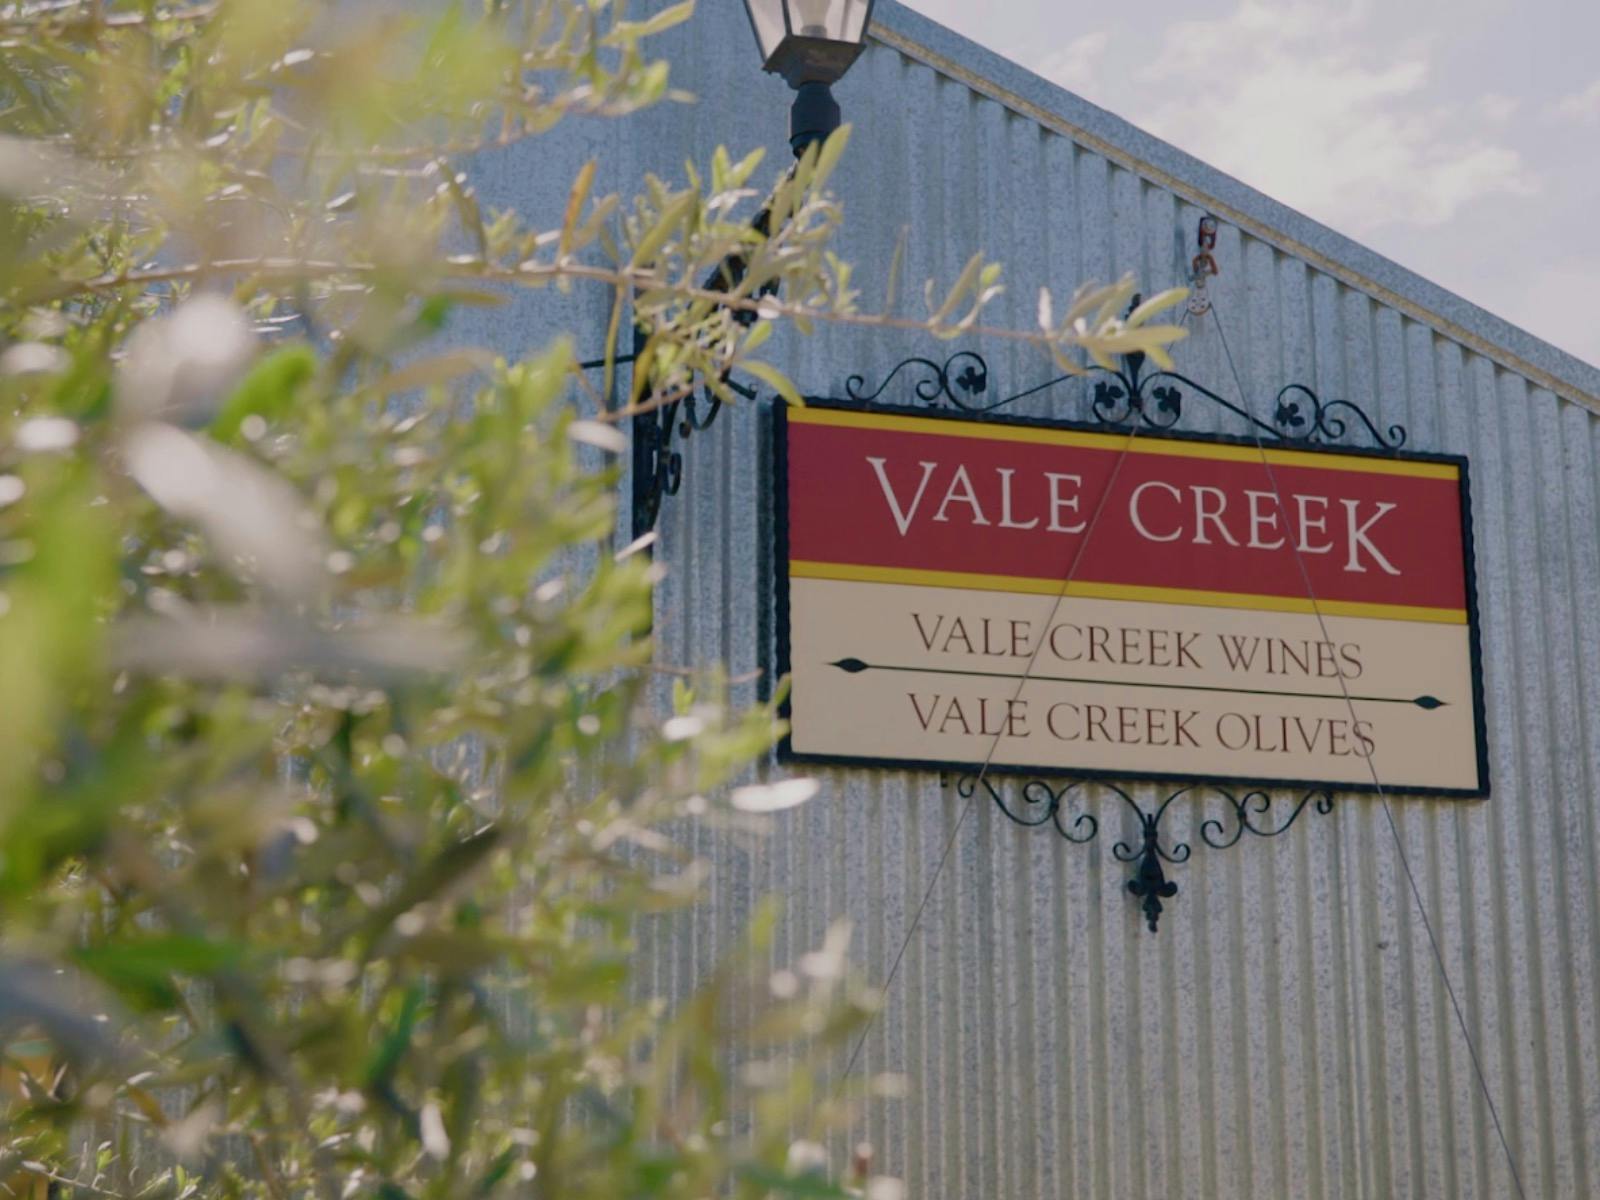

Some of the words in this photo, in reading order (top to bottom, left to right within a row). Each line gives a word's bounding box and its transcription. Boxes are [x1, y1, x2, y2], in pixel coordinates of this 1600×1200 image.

[866, 457, 1087, 537] VALE
[1129, 481, 1401, 576] CREEK
[911, 613, 1034, 658] VALE
[1049, 624, 1204, 671] CREEK
[1217, 634, 1364, 680] WINES
[906, 693, 1031, 737] VALE
[1047, 703, 1202, 749] CREEK
[1216, 713, 1376, 759] OLIVES
